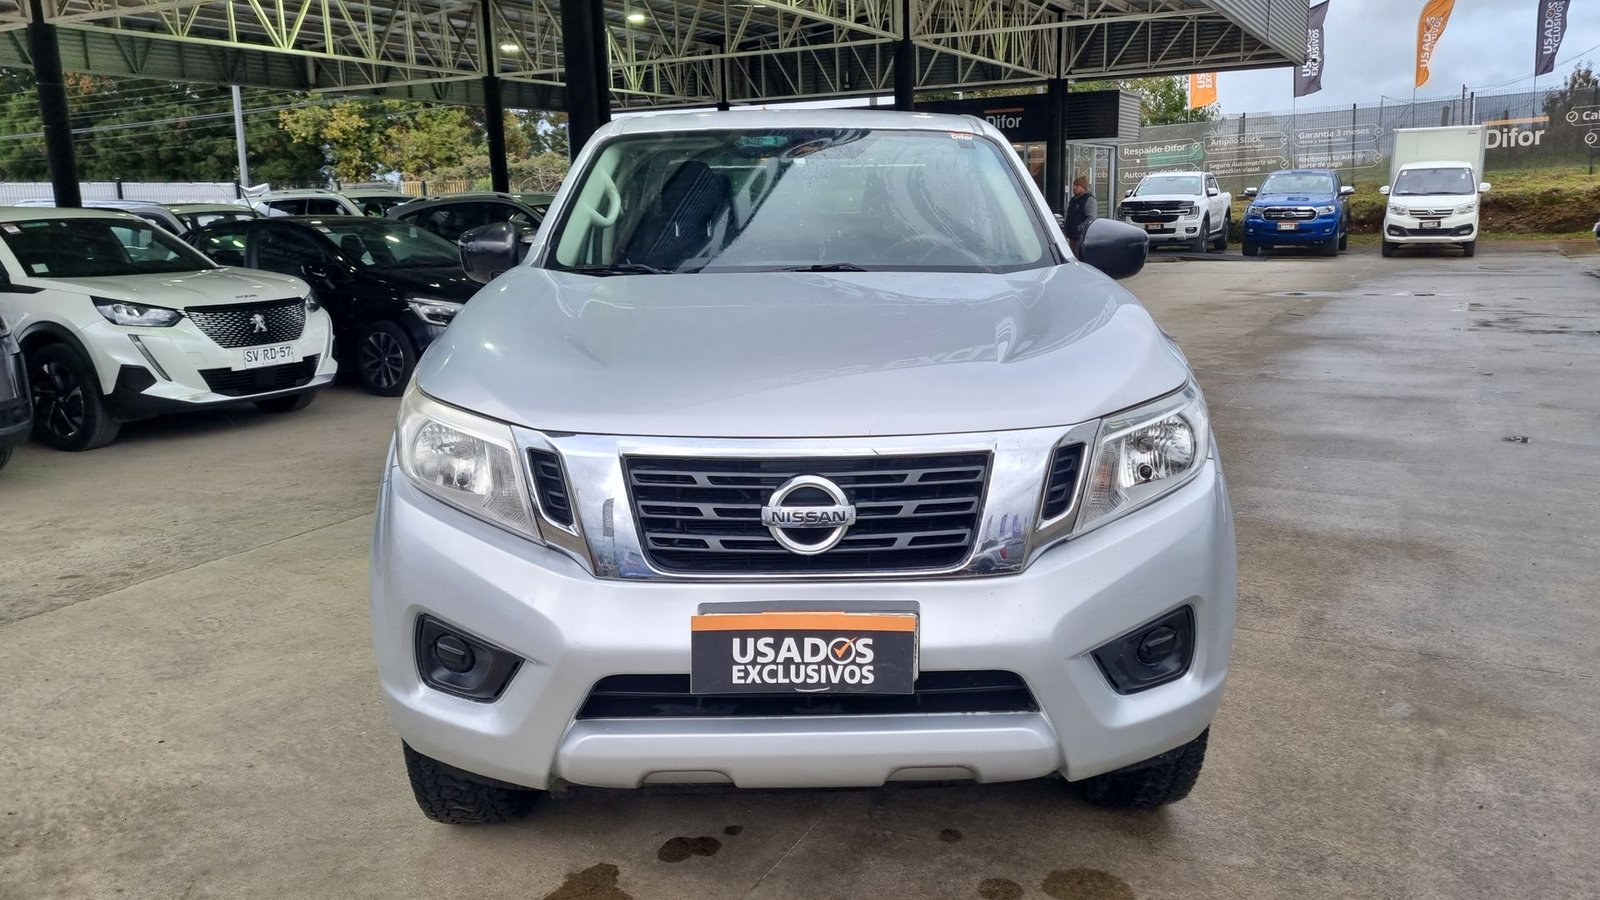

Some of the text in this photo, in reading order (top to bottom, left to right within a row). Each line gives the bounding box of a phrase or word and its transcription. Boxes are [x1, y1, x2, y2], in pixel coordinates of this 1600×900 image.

[1543, 2, 1558, 54] USADOS
[1420, 16, 1436, 68] USADOS
[986, 115, 1022, 129] Difor
[1343, 128, 1369, 136] meses
[1485, 127, 1545, 149] Difor
[1210, 135, 1262, 146] Amplio Stock
[1123, 144, 1187, 157] Respaldo Difor
[1209, 162, 1230, 170] Seguro
[1231, 160, 1266, 168] Automotriz
[1242, 165, 1260, 173] visual
[1123, 171, 1147, 179] Autos
[246, 346, 291, 362] SV RD 57
[771, 510, 846, 524] NISSAN
[732, 637, 874, 664] USADOS
[732, 665, 874, 684] EXCLUSIVOS
